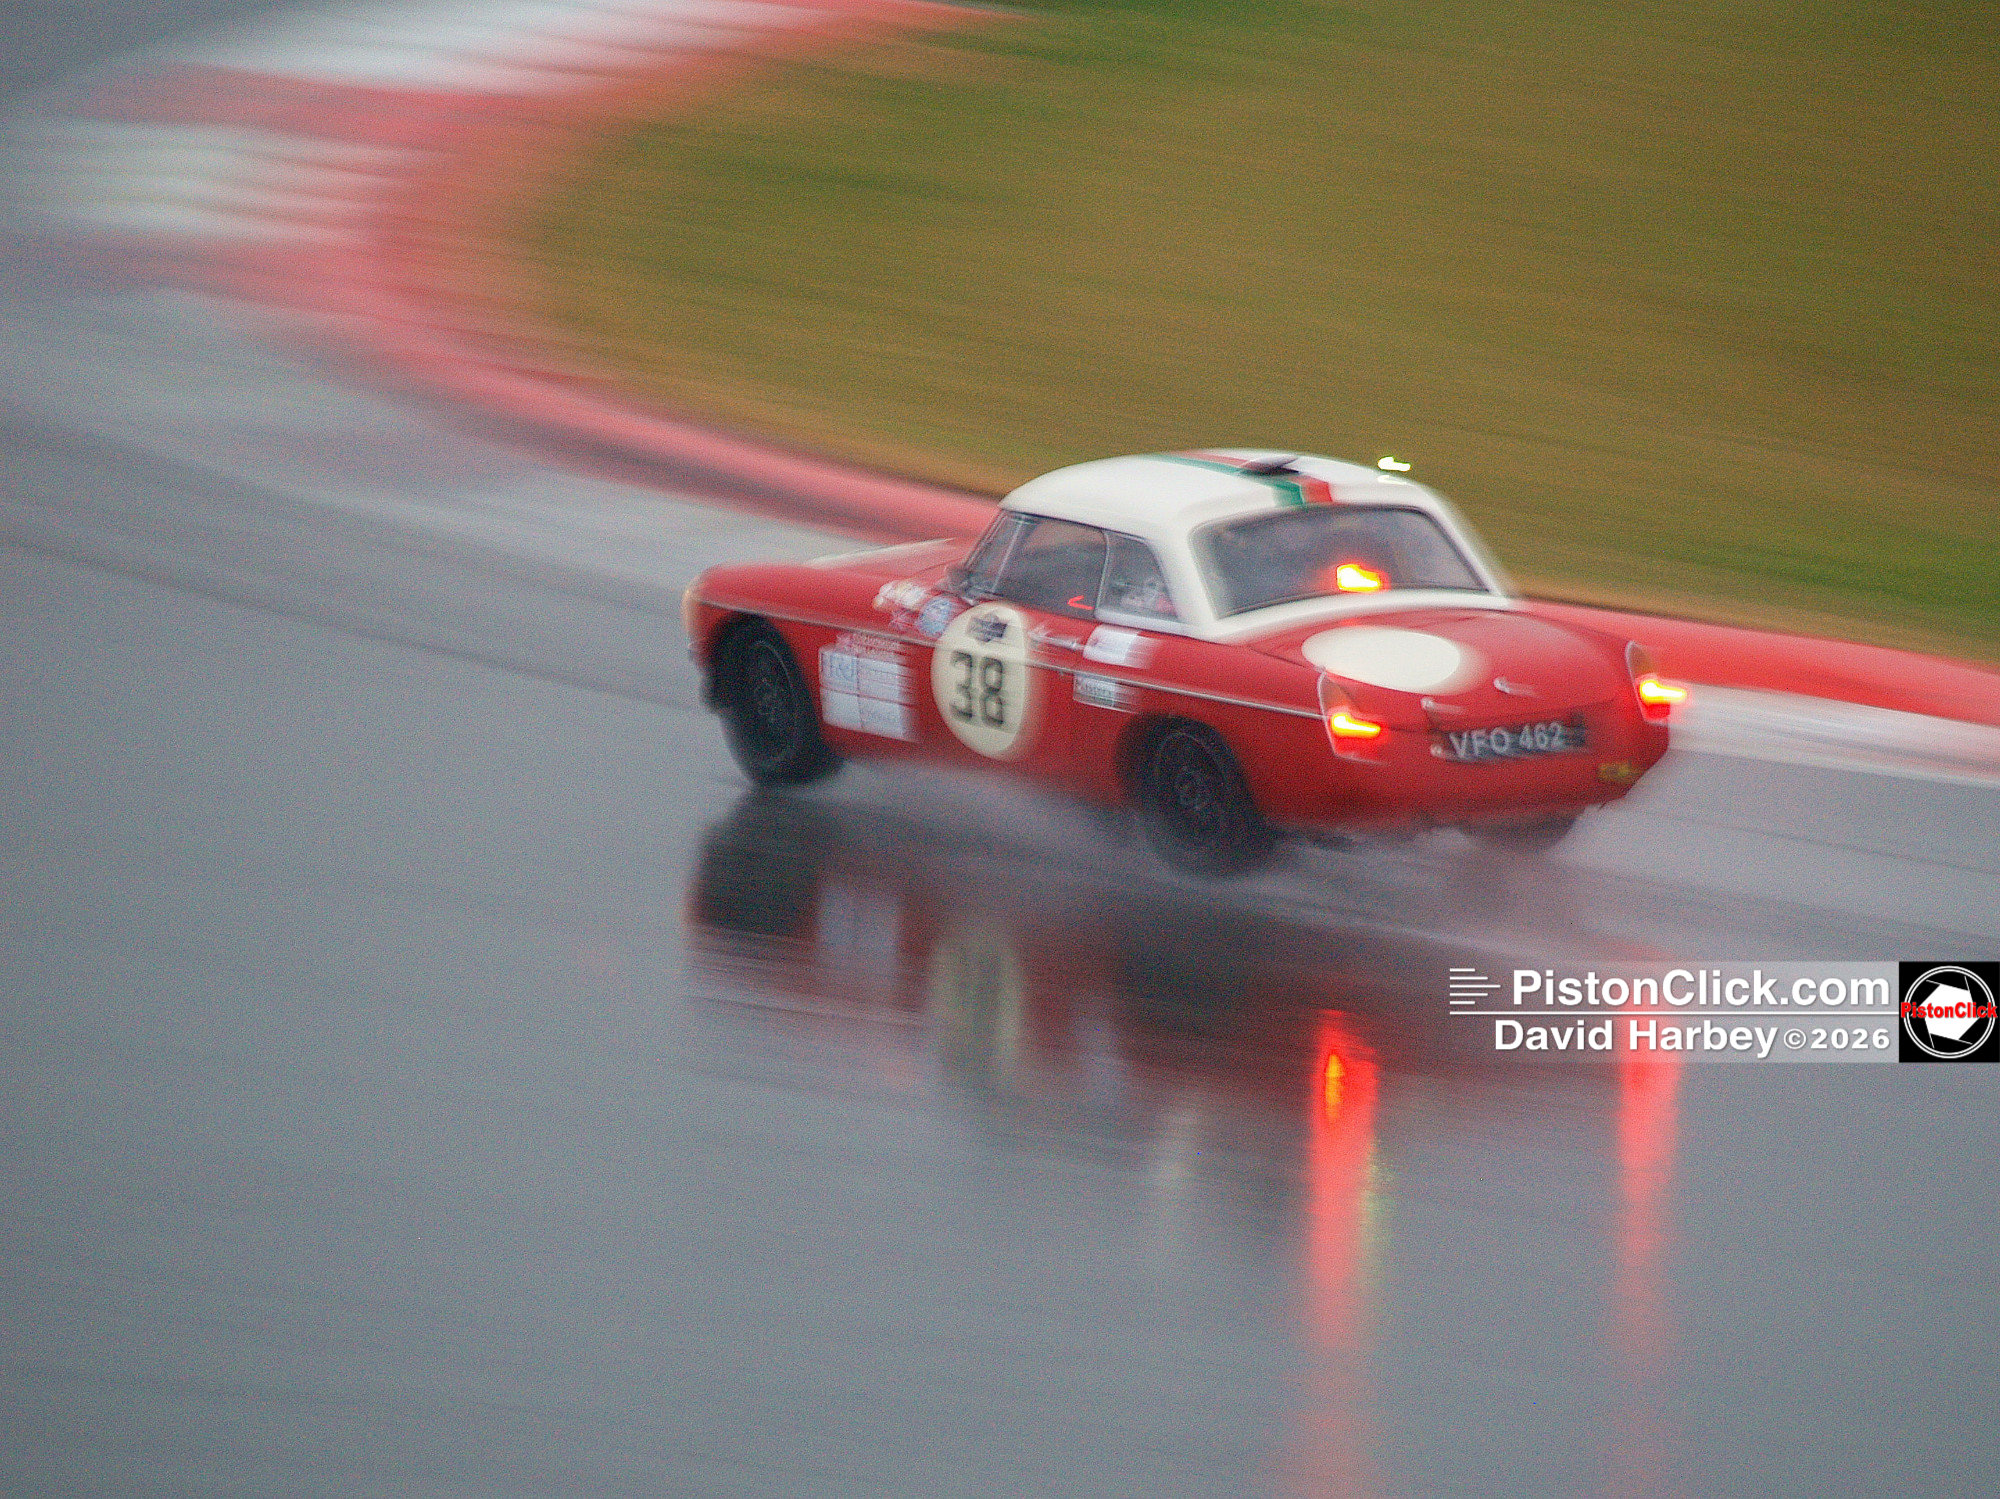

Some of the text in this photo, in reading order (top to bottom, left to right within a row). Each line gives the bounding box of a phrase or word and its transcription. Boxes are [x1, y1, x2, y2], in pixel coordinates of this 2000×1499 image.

[951, 650, 1004, 726] 38
[1450, 721, 1565, 758] VFO 462
